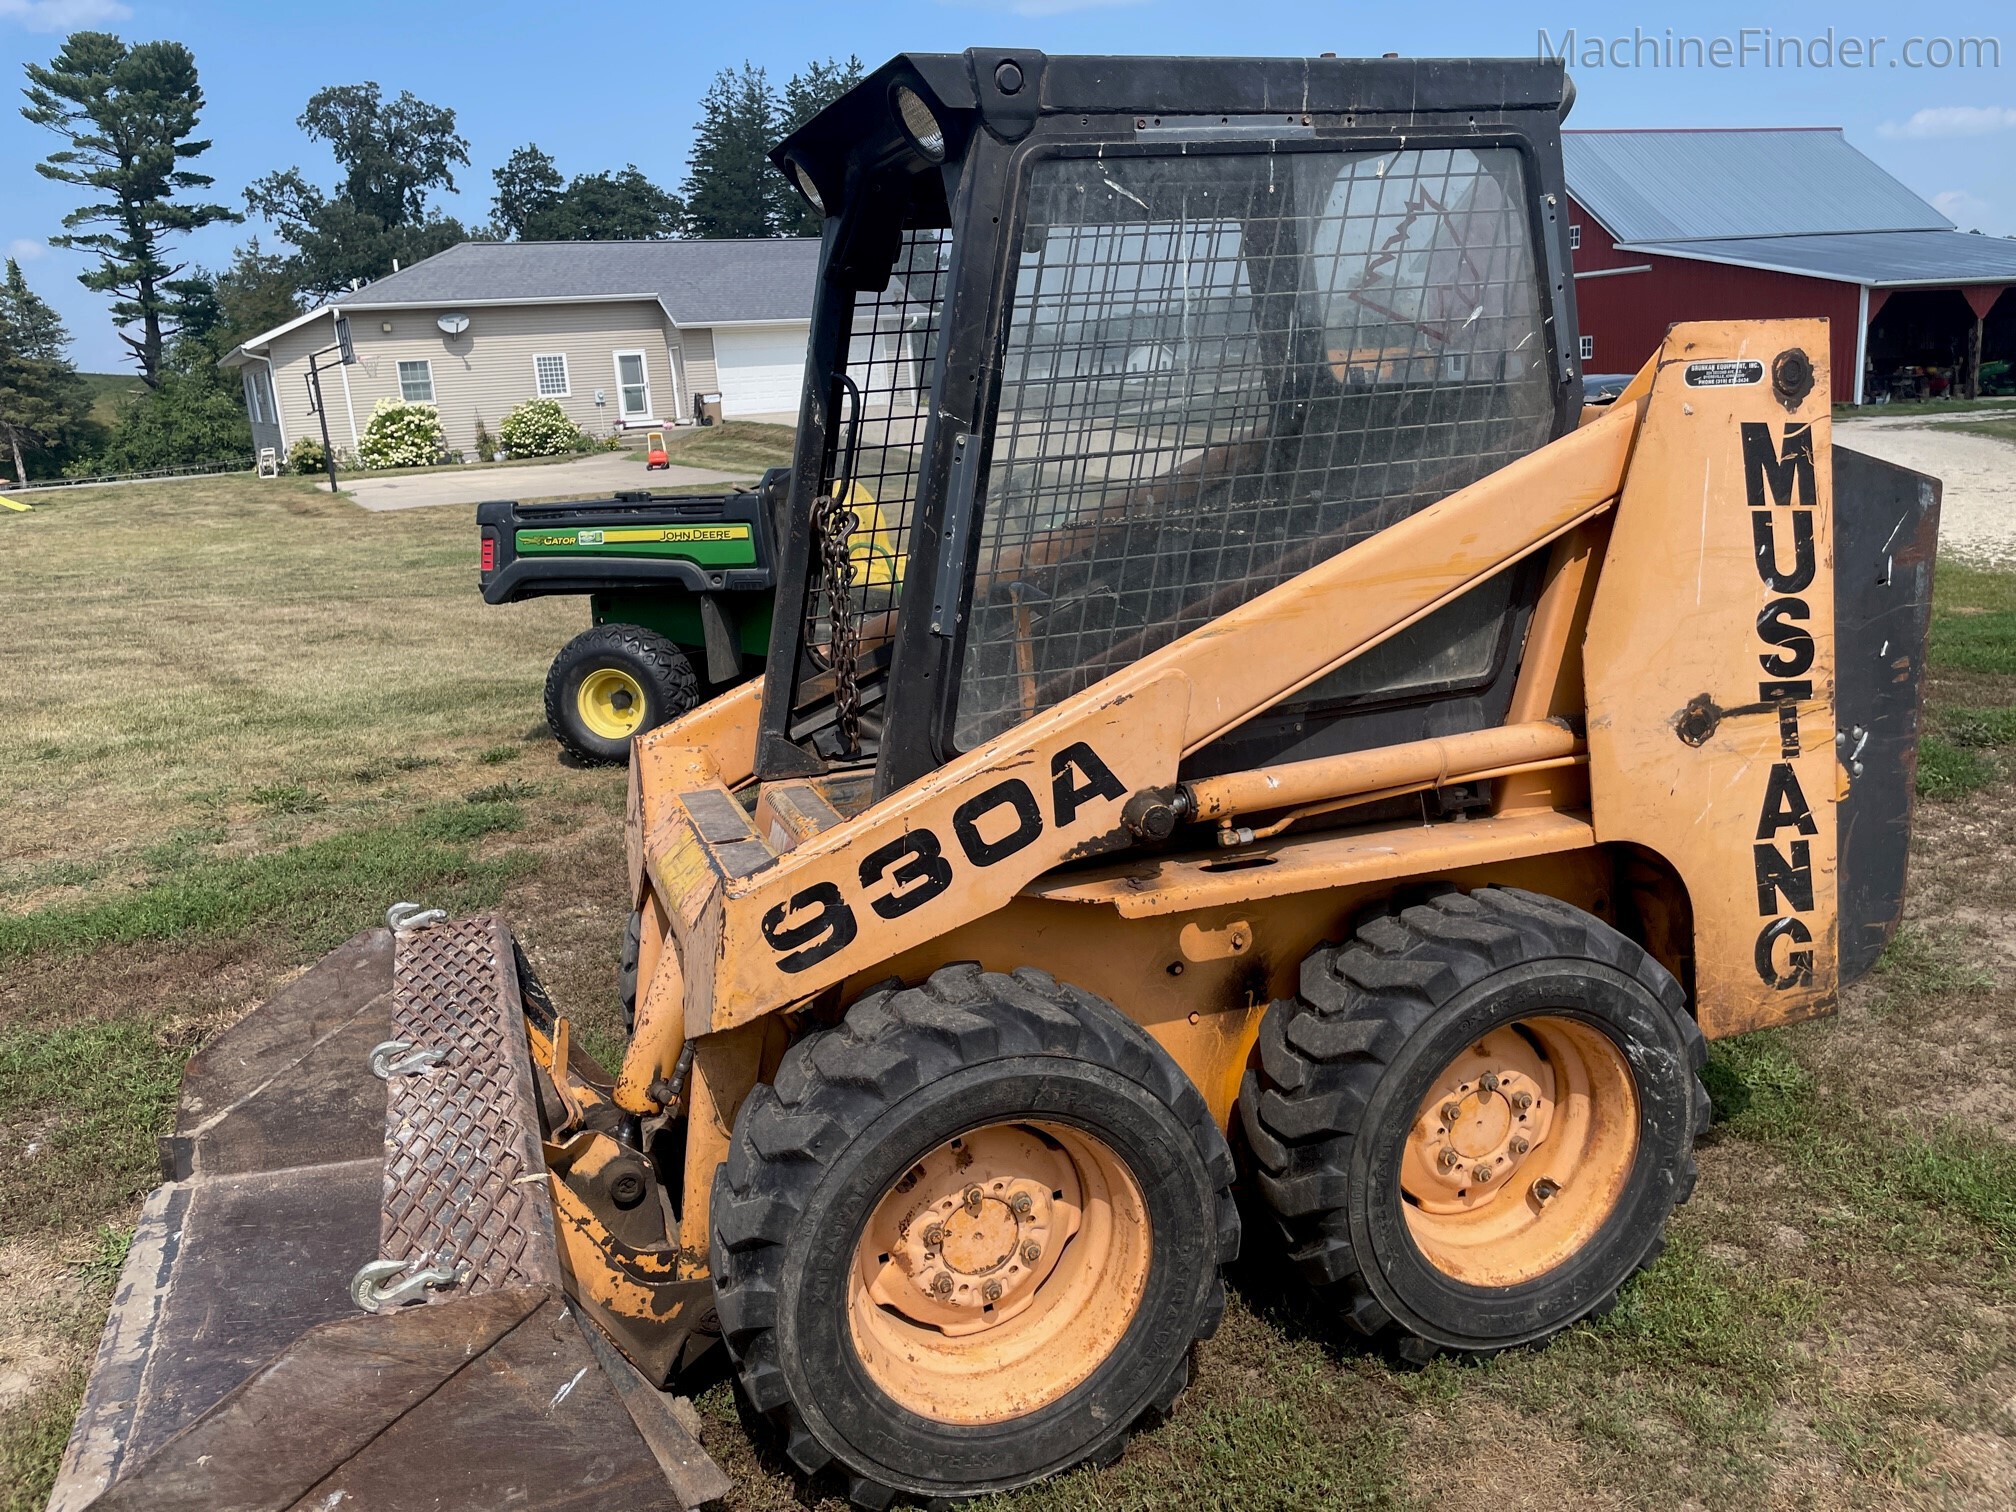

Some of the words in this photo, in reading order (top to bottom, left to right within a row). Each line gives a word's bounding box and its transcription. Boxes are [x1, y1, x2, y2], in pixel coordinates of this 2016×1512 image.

[543, 536, 577, 545] GATOR
[660, 530, 693, 541] JOHN
[693, 529, 731, 540] DEERE
[1740, 422, 1818, 990] MUSTANG
[761, 741, 1128, 974] 930A
